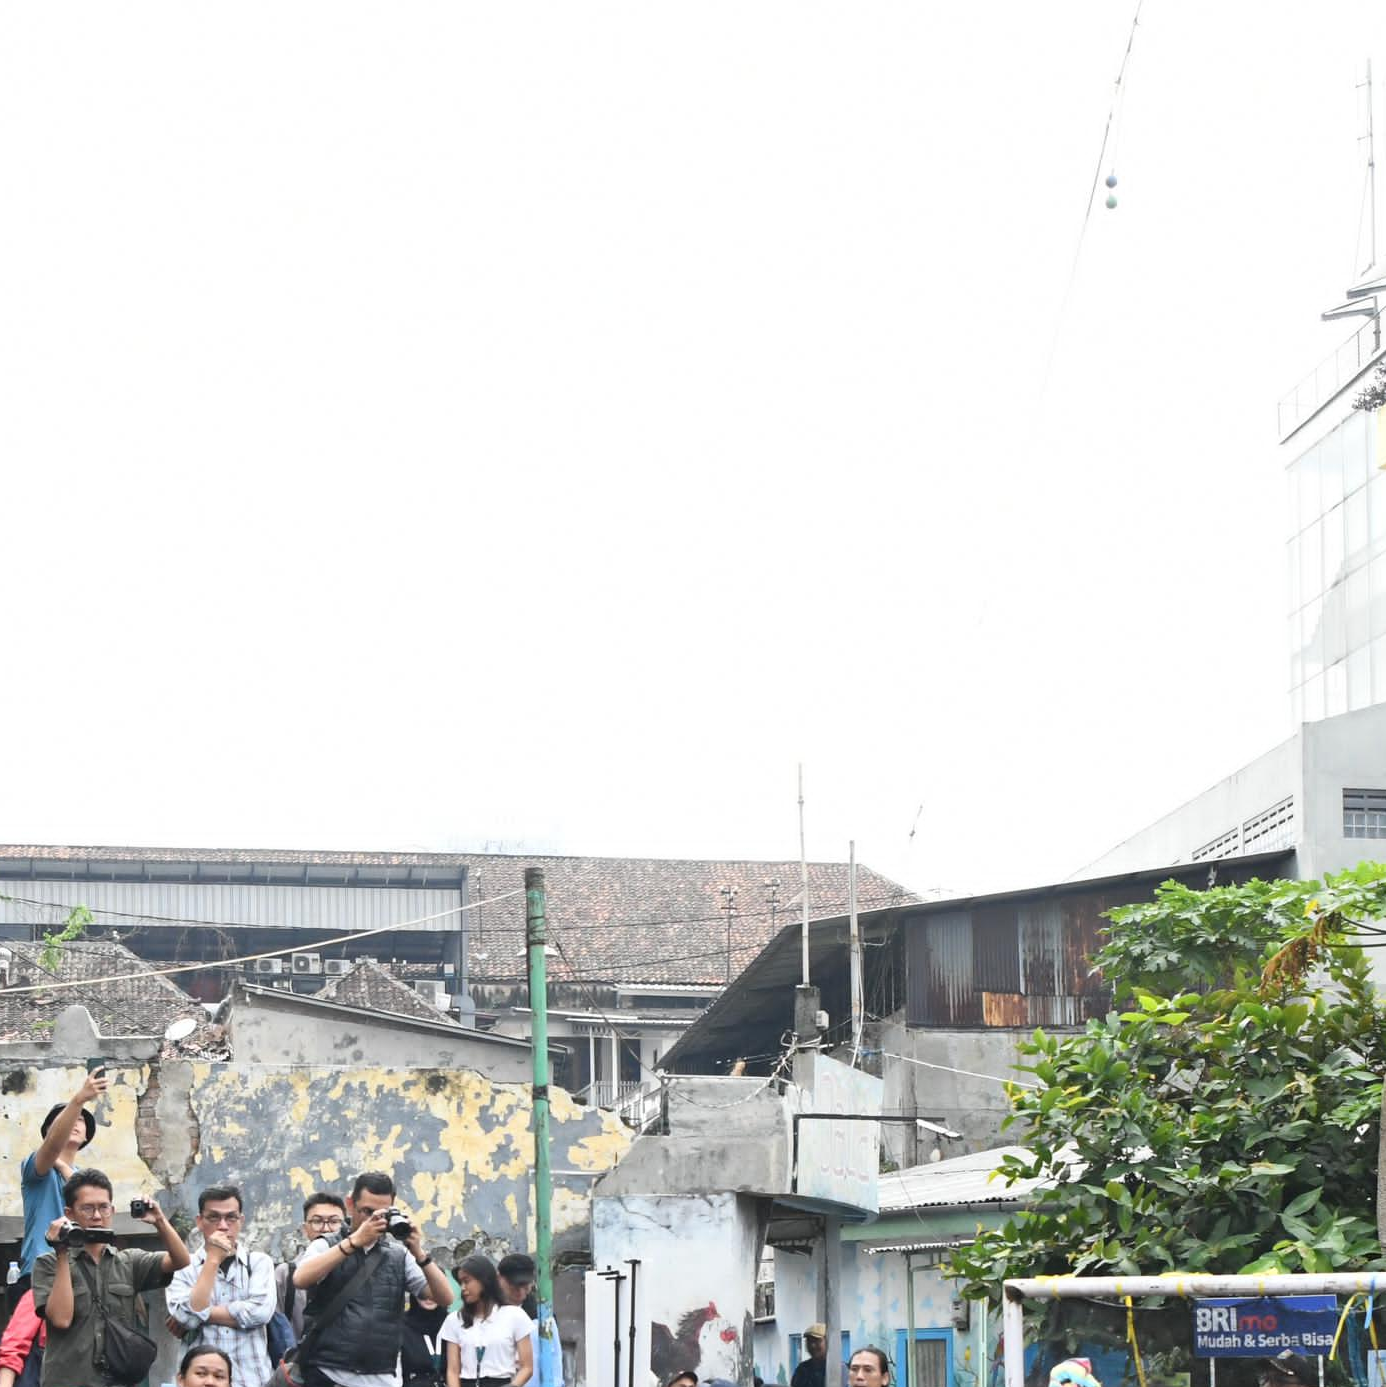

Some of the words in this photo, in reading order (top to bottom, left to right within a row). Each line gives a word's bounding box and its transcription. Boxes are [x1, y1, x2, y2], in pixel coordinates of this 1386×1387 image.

[1196, 1307, 1278, 1332] BRImo
[1197, 1333, 1241, 1348] Mudah
[1244, 1333, 1255, 1348] &
[1258, 1333, 1300, 1347] Serba
[1302, 1332, 1335, 1346] Bisa
